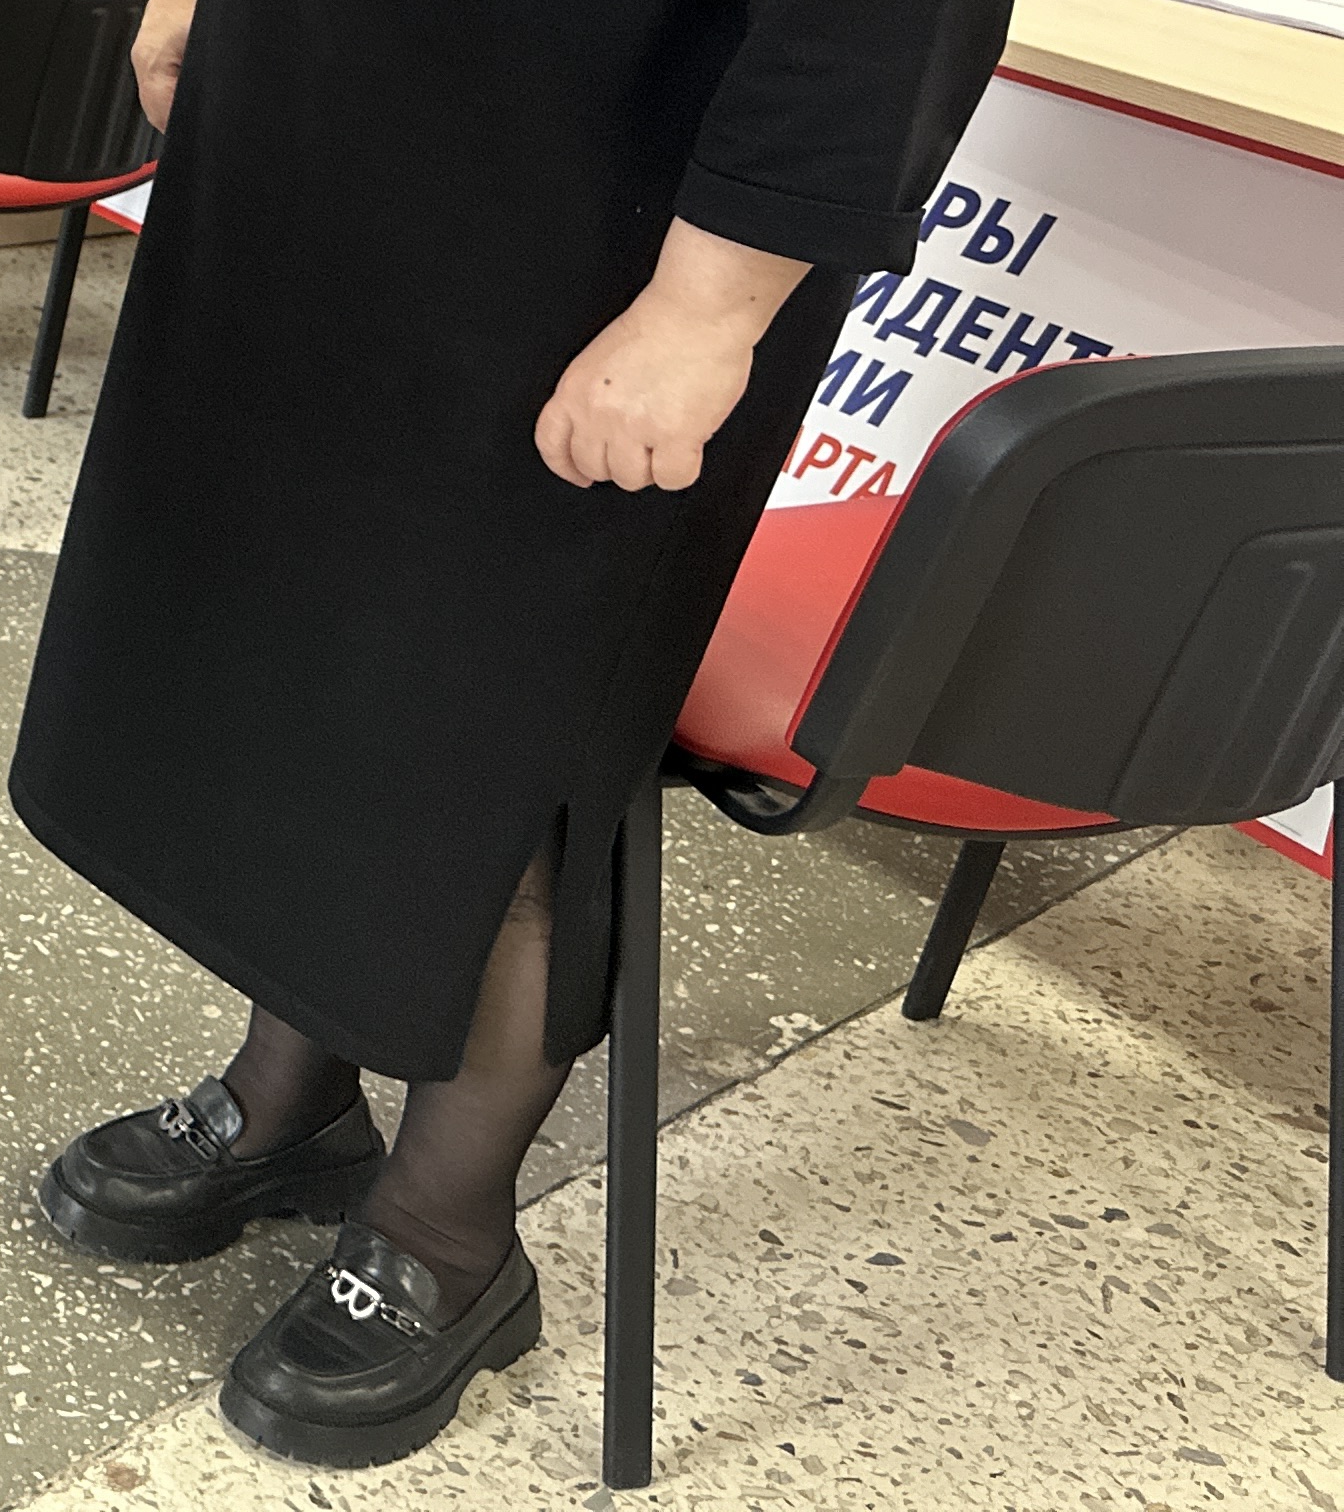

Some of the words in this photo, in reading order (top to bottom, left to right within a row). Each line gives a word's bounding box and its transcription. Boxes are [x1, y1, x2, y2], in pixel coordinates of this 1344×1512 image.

[919, 181, 1058, 277] РЫ
[848, 274, 1116, 374] ИДЕНТ
[817, 348, 914, 428] ИИ
[781, 424, 900, 499] РТА
